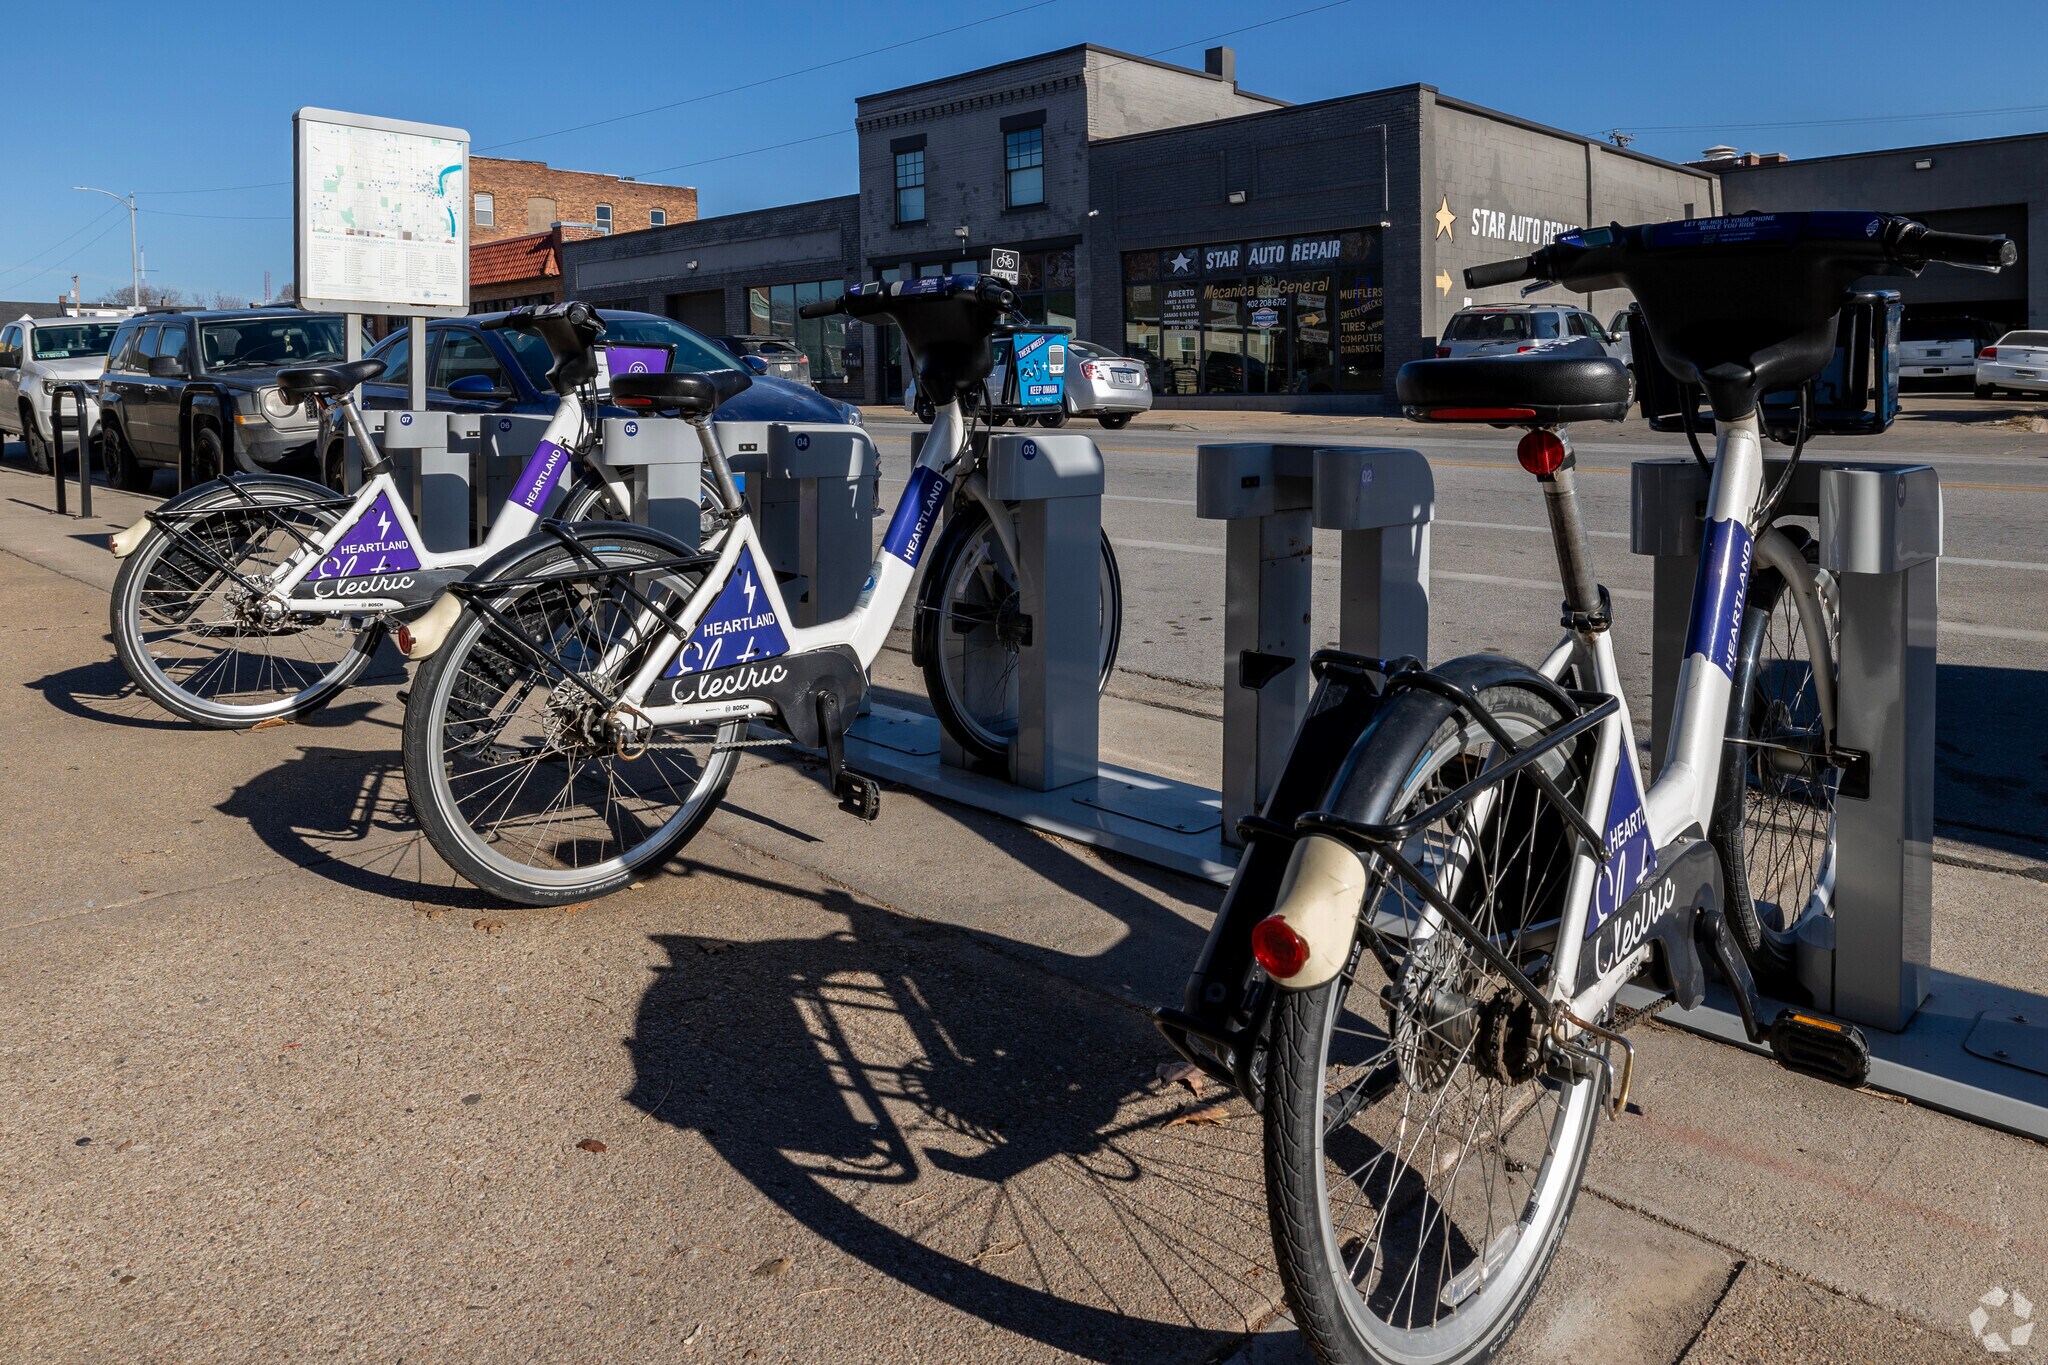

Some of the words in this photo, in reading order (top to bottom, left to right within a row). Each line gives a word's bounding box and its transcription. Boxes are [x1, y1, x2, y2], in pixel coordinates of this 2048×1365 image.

[1471, 207, 1505, 240] STAR
[1508, 214, 1540, 244] AUTO
[1206, 250, 1239, 269] STAR
[1248, 245, 1285, 265] AUTO
[1291, 240, 1340, 261] REPAIR
[1168, 289, 1195, 298] ABIERTO
[1203, 283, 1254, 299] Mecanica
[1278, 276, 1330, 294] General
[1340, 288, 1383, 299] MUFFLERS
[1247, 300, 1259, 308] 402
[1340, 308, 1361, 320] SAFETY
[1361, 299, 1383, 313] CHECKS
[1341, 321, 1366, 332] TIRES
[1340, 333, 1383, 343] COMPUTER
[1018, 345, 1032, 359] THESE
[1030, 335, 1046, 352] WHEELS
[1340, 344, 1382, 354] DIAGNOSTIC
[1029, 385, 1042, 395] KEEP
[1042, 384, 1058, 394] OMAHA
[401, 416, 411, 424] 07
[625, 425, 637, 433] 05
[797, 437, 808, 447] 04
[1023, 445, 1035, 455] 03
[524, 449, 562, 507] HEARTLAND
[1362, 470, 1372, 482] 02
[1898, 481, 1905, 499] 01
[903, 480, 943, 560] HEARTLAND
[341, 540, 409, 554] HEARTLAND
[314, 555, 415, 598] Electric
[1725, 540, 1750, 672] HEARTLAND
[704, 612, 775, 637] HEARTLAND
[671, 636, 788, 703] Electric
[1595, 838, 1676, 977] Electric
